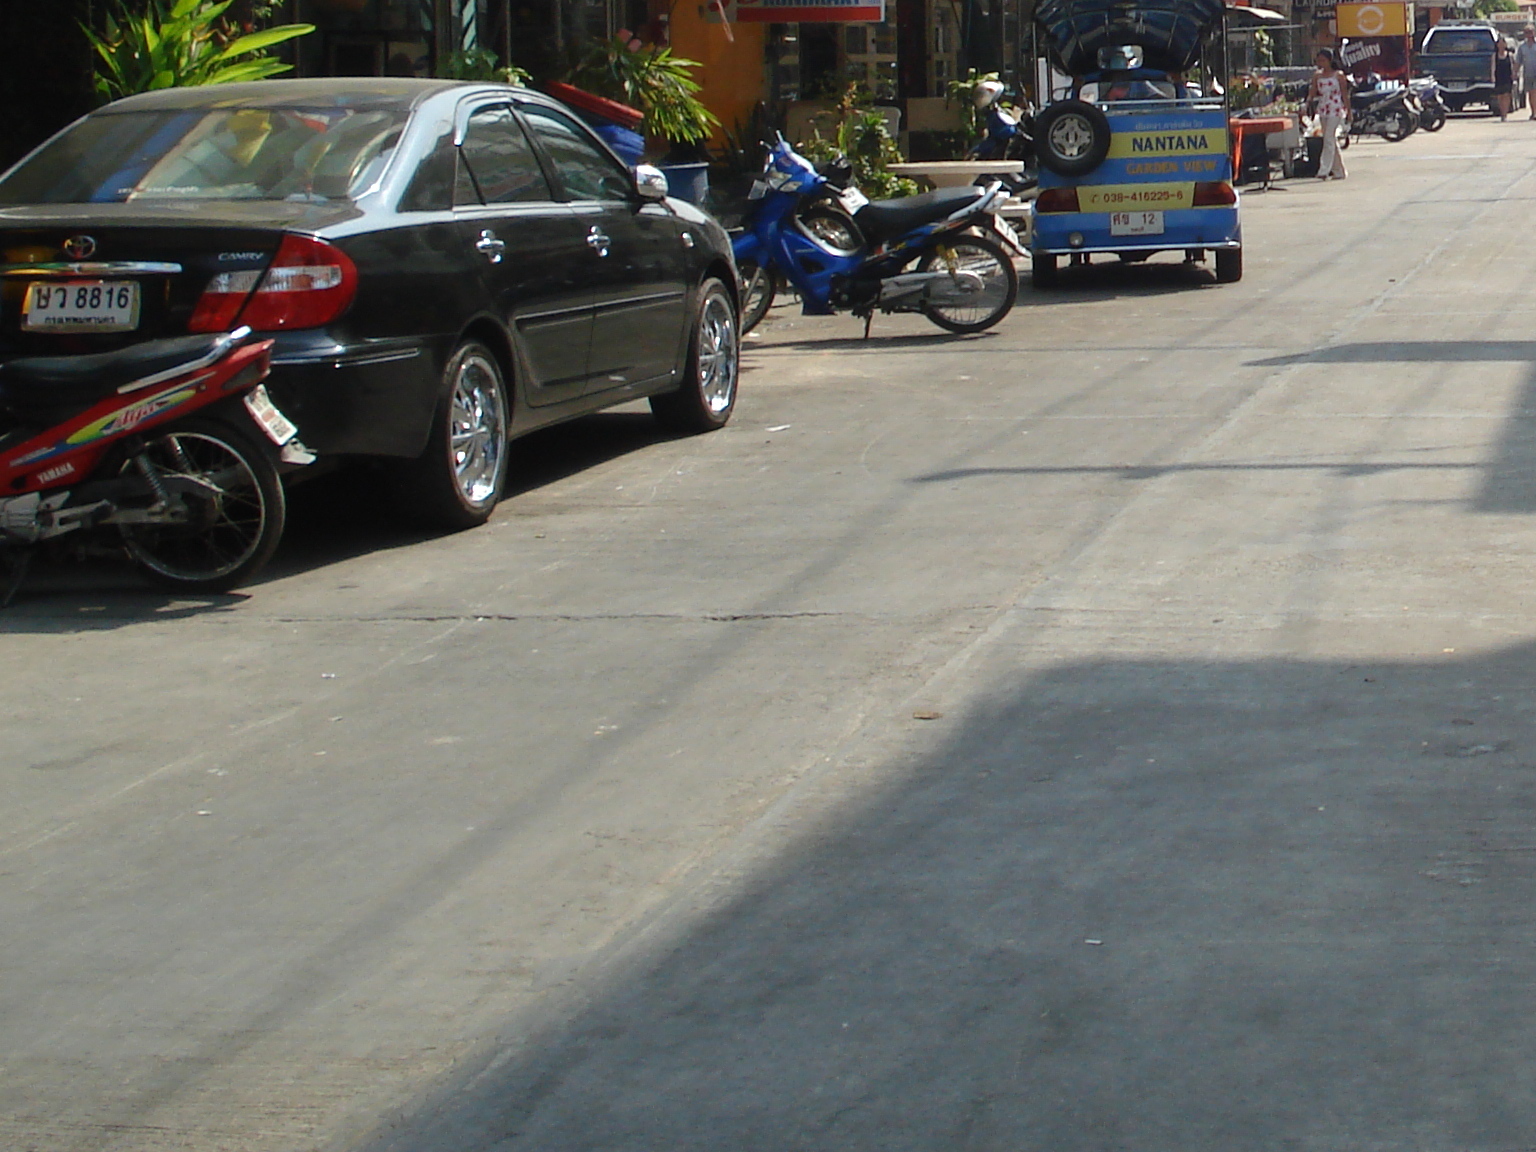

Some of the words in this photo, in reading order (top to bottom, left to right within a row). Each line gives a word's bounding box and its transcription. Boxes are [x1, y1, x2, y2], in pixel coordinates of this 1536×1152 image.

[1132, 135, 1208, 152] NANTANA
[1127, 161, 1178, 175] GARDEN
[1184, 160, 1217, 173] VIEW
[1142, 213, 1155, 225] 12
[218, 252, 264, 262] CAMRY
[76, 287, 130, 309] 8816
[36, 462, 75, 485] YAMAHA
